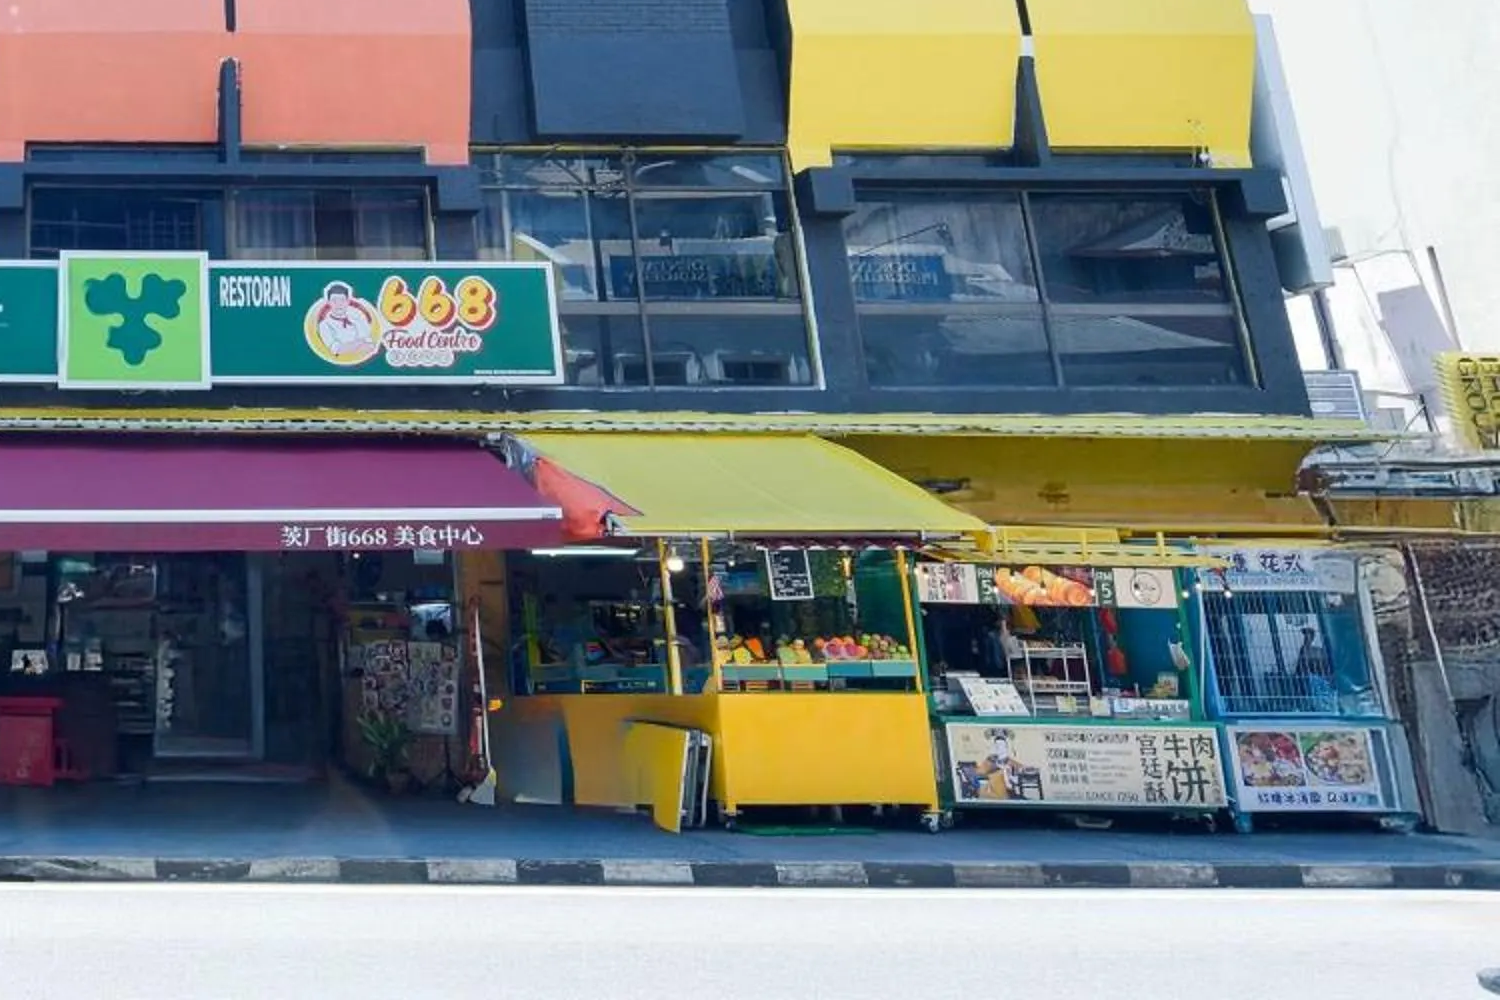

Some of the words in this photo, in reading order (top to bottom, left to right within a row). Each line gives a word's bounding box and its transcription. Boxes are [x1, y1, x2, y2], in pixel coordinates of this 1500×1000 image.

[219, 275, 291, 307] RESTORAN
[380, 277, 496, 329] 668
[384, 329, 426, 349] Food
[393, 525, 485, 547] 美食中心
[981, 579, 993, 595] 5
[1101, 583, 1114, 599] 5
